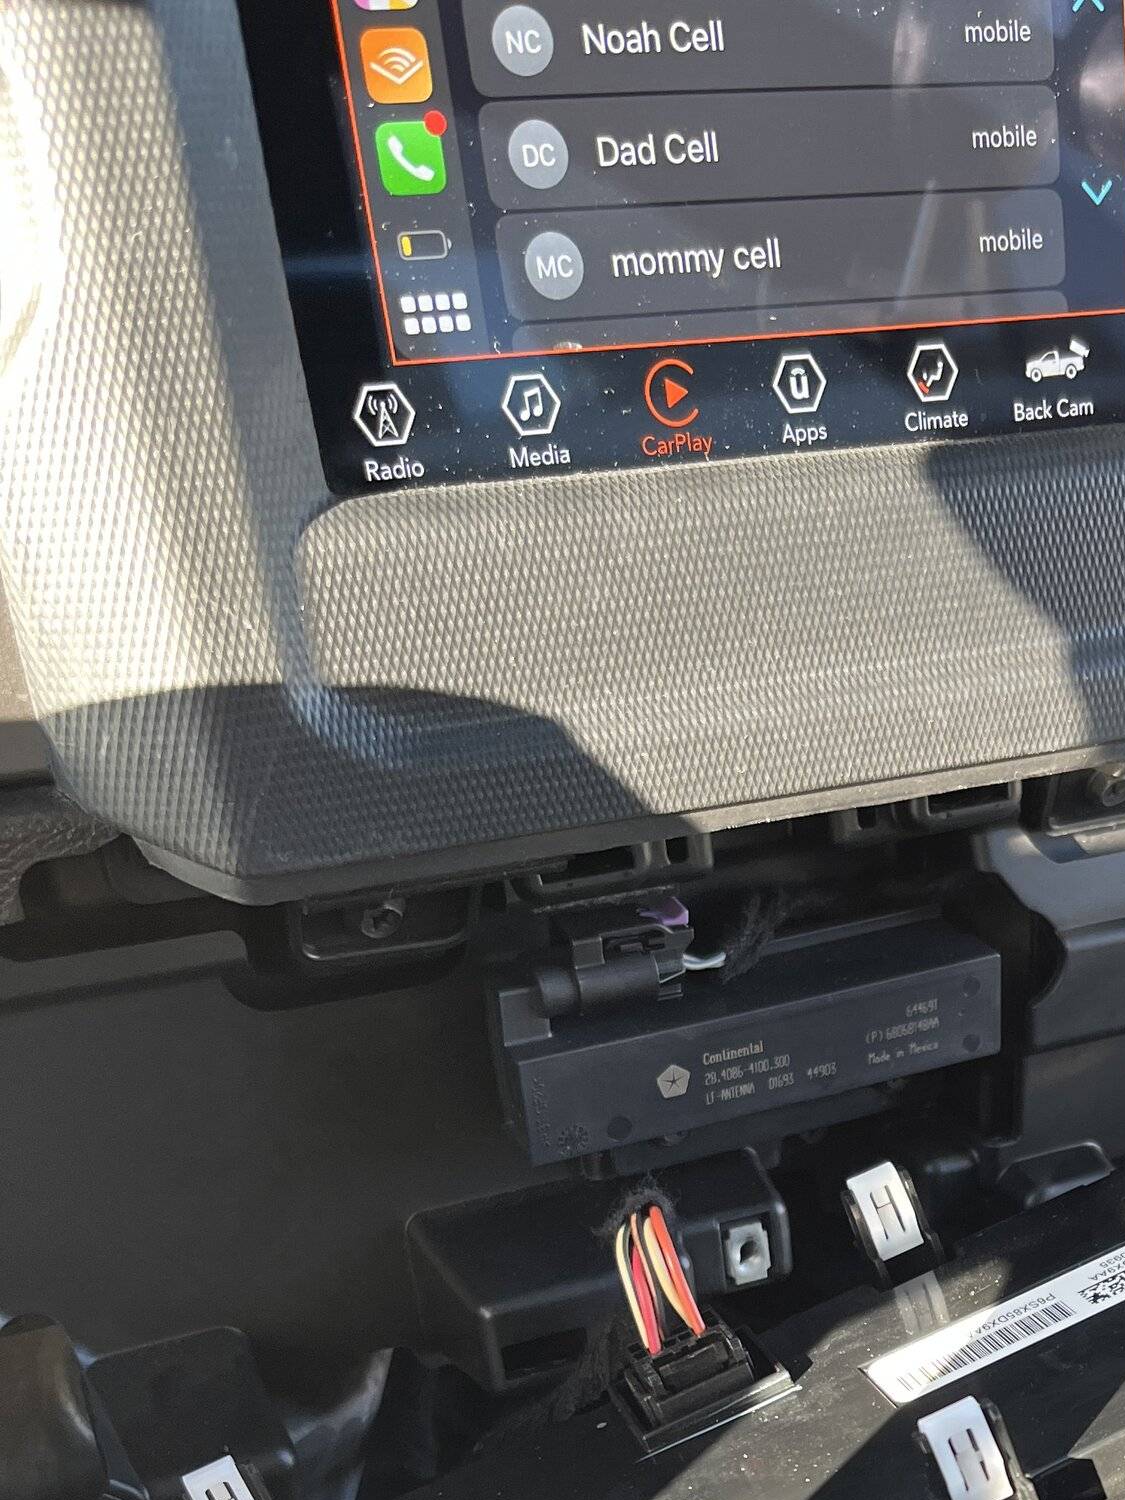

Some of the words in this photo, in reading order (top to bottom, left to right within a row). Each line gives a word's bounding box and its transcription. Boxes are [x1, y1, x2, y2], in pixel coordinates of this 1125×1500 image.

[505, 29, 542, 55] NC
[582, 24, 661, 56] Noah
[668, 20, 725, 53] Cell
[964, 21, 1032, 44] mobile
[597, 133, 657, 168] Dad
[664, 131, 719, 164] Cell
[972, 125, 1038, 149] mobile
[521, 142, 557, 169] DC
[979, 229, 1044, 254] mobile
[535, 254, 575, 279] MC
[612, 246, 726, 279] mommy
[733, 237, 781, 272] cell
[905, 410, 969, 433] Climate
[1014, 402, 1053, 423] Back
[1056, 398, 1095, 420] Cam
[641, 432, 713, 458] CarPlay
[782, 423, 828, 446] Apps
[364, 458, 426, 482] Radio
[509, 445, 571, 470] Media
[702, 1040, 764, 1066] Continental
[867, 1049, 890, 1065] Made
